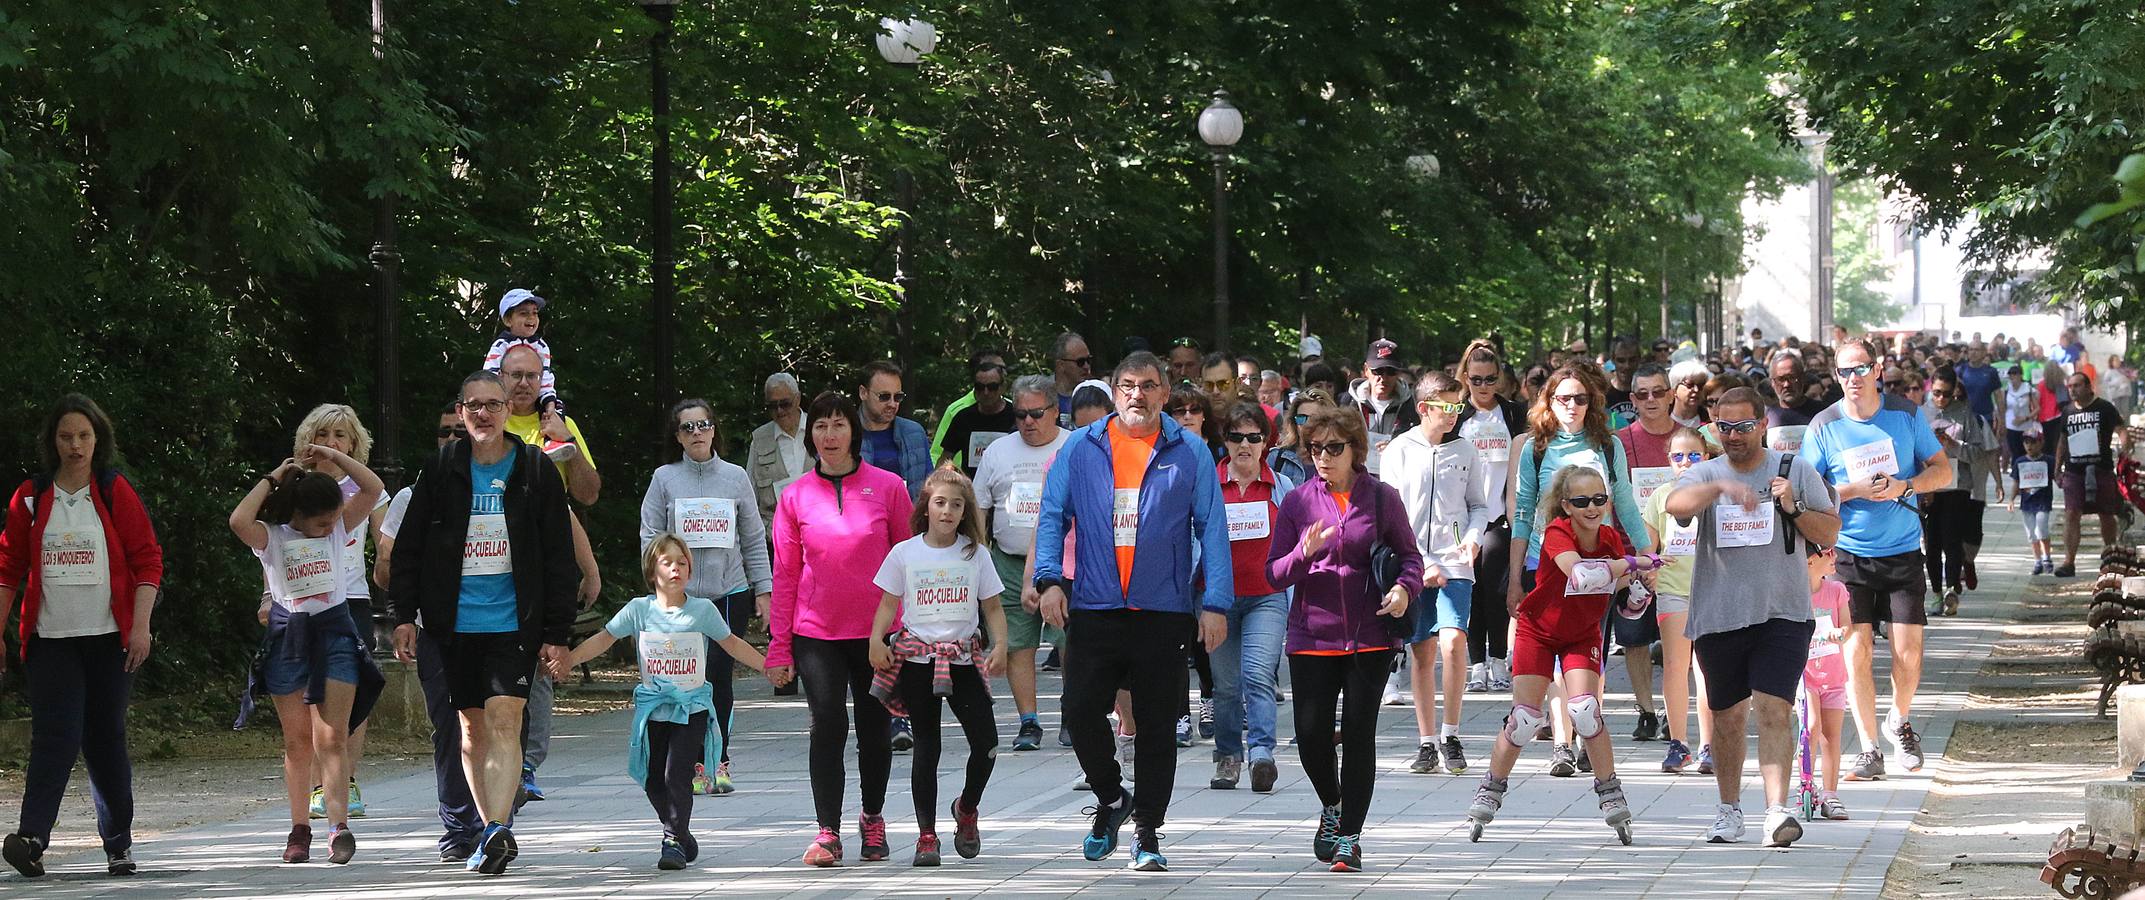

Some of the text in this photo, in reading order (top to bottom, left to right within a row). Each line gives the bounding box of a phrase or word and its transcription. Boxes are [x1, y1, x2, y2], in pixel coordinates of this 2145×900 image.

[2067, 412, 2100, 424] FUTURE
[683, 518, 729, 533] GOMEZ-GUICHO
[1120, 513, 1139, 529] ANTO
[1231, 522, 1244, 531] BEST
[1245, 521, 1265, 530] FAMILY
[1722, 520, 1769, 532] THE BEST FAMILY
[463, 541, 508, 558] CO-CUELLAR
[43, 552, 53, 566] LOS
[57, 550, 96, 567] MOSQUETEROS
[917, 587, 969, 606] RICO-CUELLAR
[647, 658, 697, 675] RICO-CUELLAR
